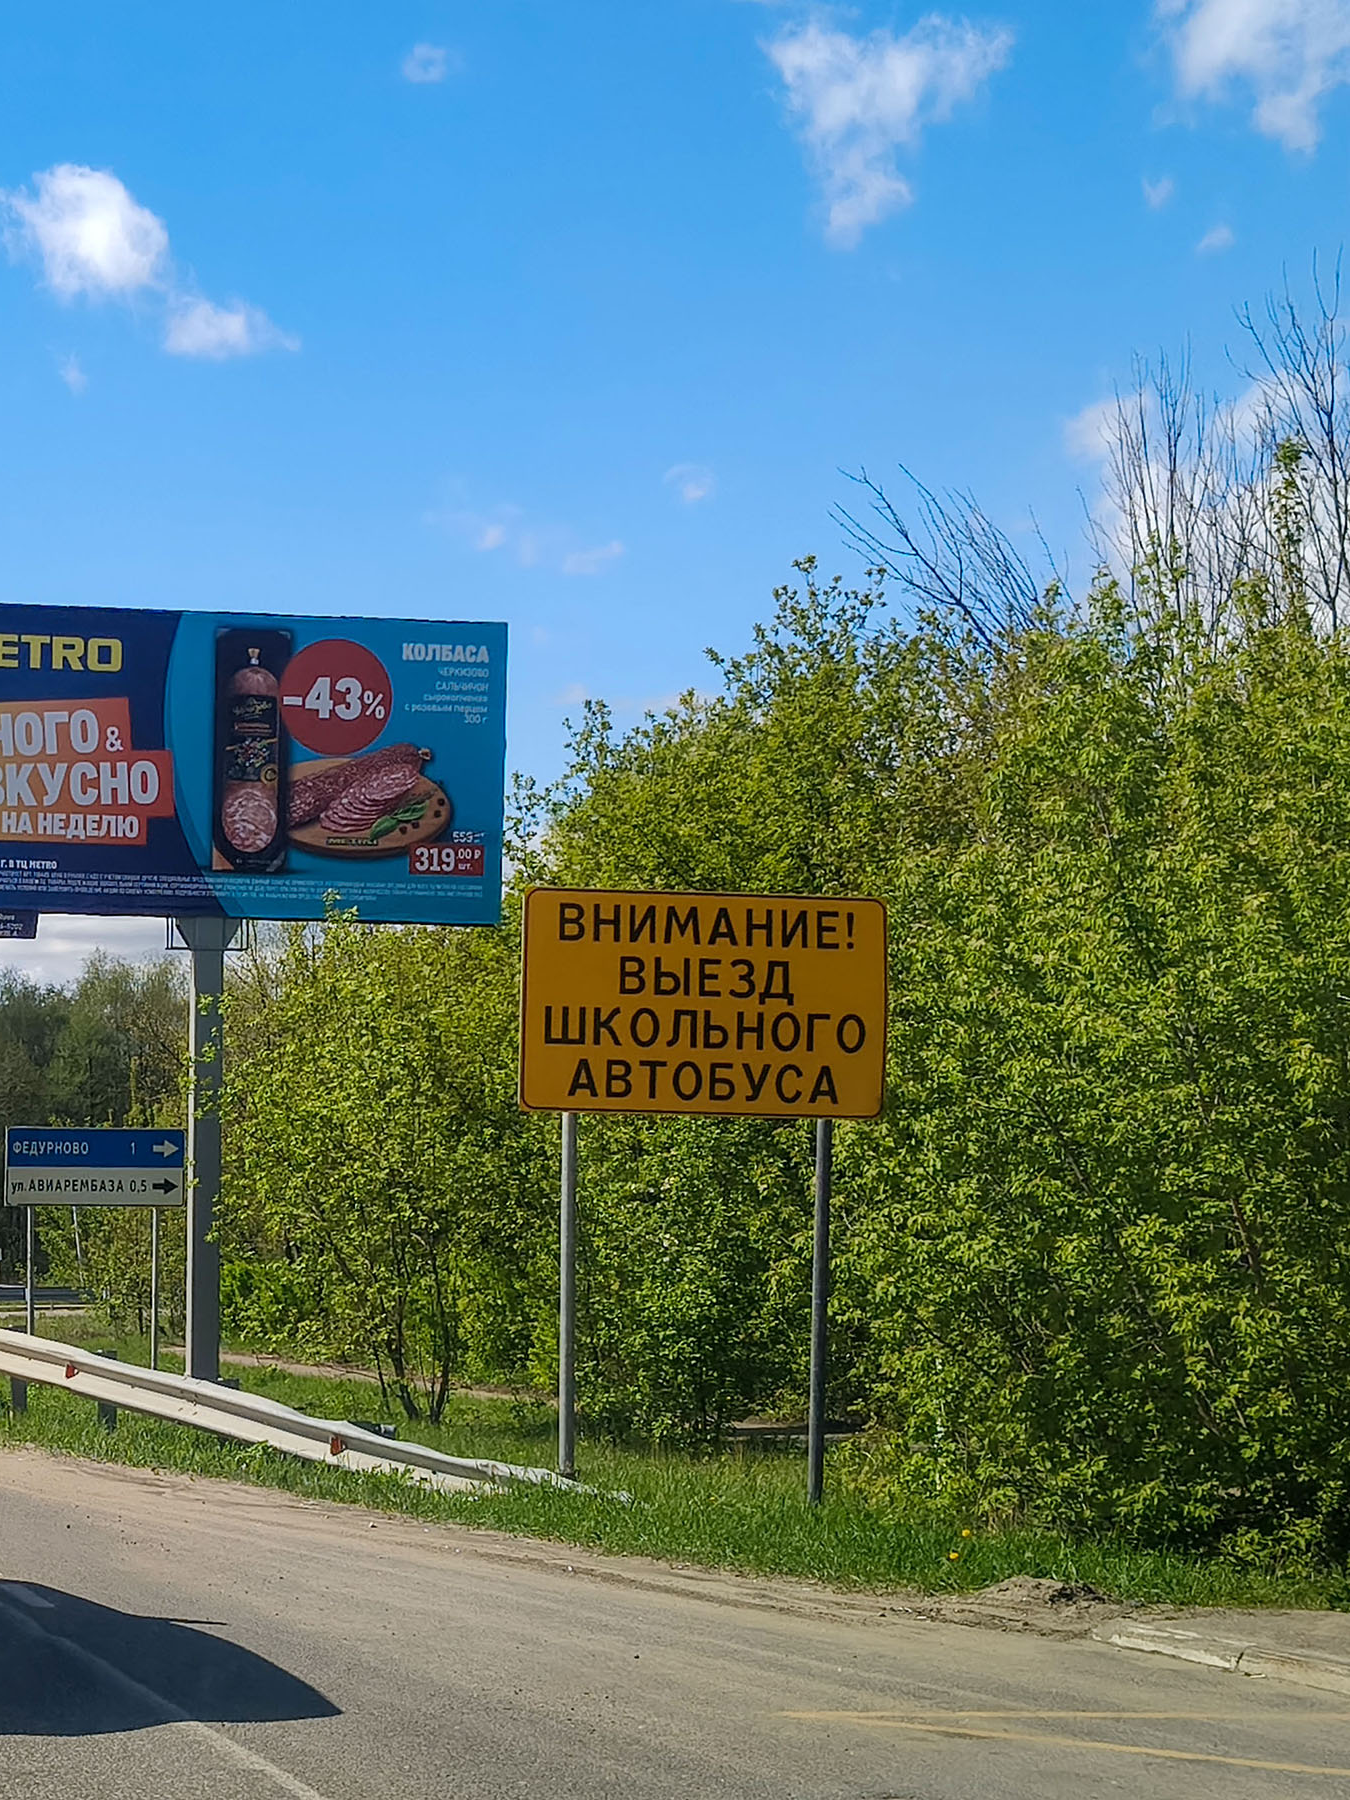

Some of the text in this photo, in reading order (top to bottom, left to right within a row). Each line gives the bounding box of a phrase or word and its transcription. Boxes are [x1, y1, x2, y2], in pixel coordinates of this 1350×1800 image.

[402, 643, 489, 663] КОЛБАСА
[282, 677, 385, 721] -43%
[105, 726, 123, 751] &
[1, 811, 139, 840] НА НЕДЕЛЮ
[16, 860, 28, 870] ТЦ
[414, 847, 455, 872] 319
[558, 902, 855, 950] ВНИМАНИЕ!
[618, 955, 795, 1006] ВЫЕЗД
[543, 1004, 867, 1054] ШКОЛЬНОГО
[567, 1058, 840, 1105] АВТОБУСА
[12, 1141, 137, 1157] ФЕДУРНОВО 1
